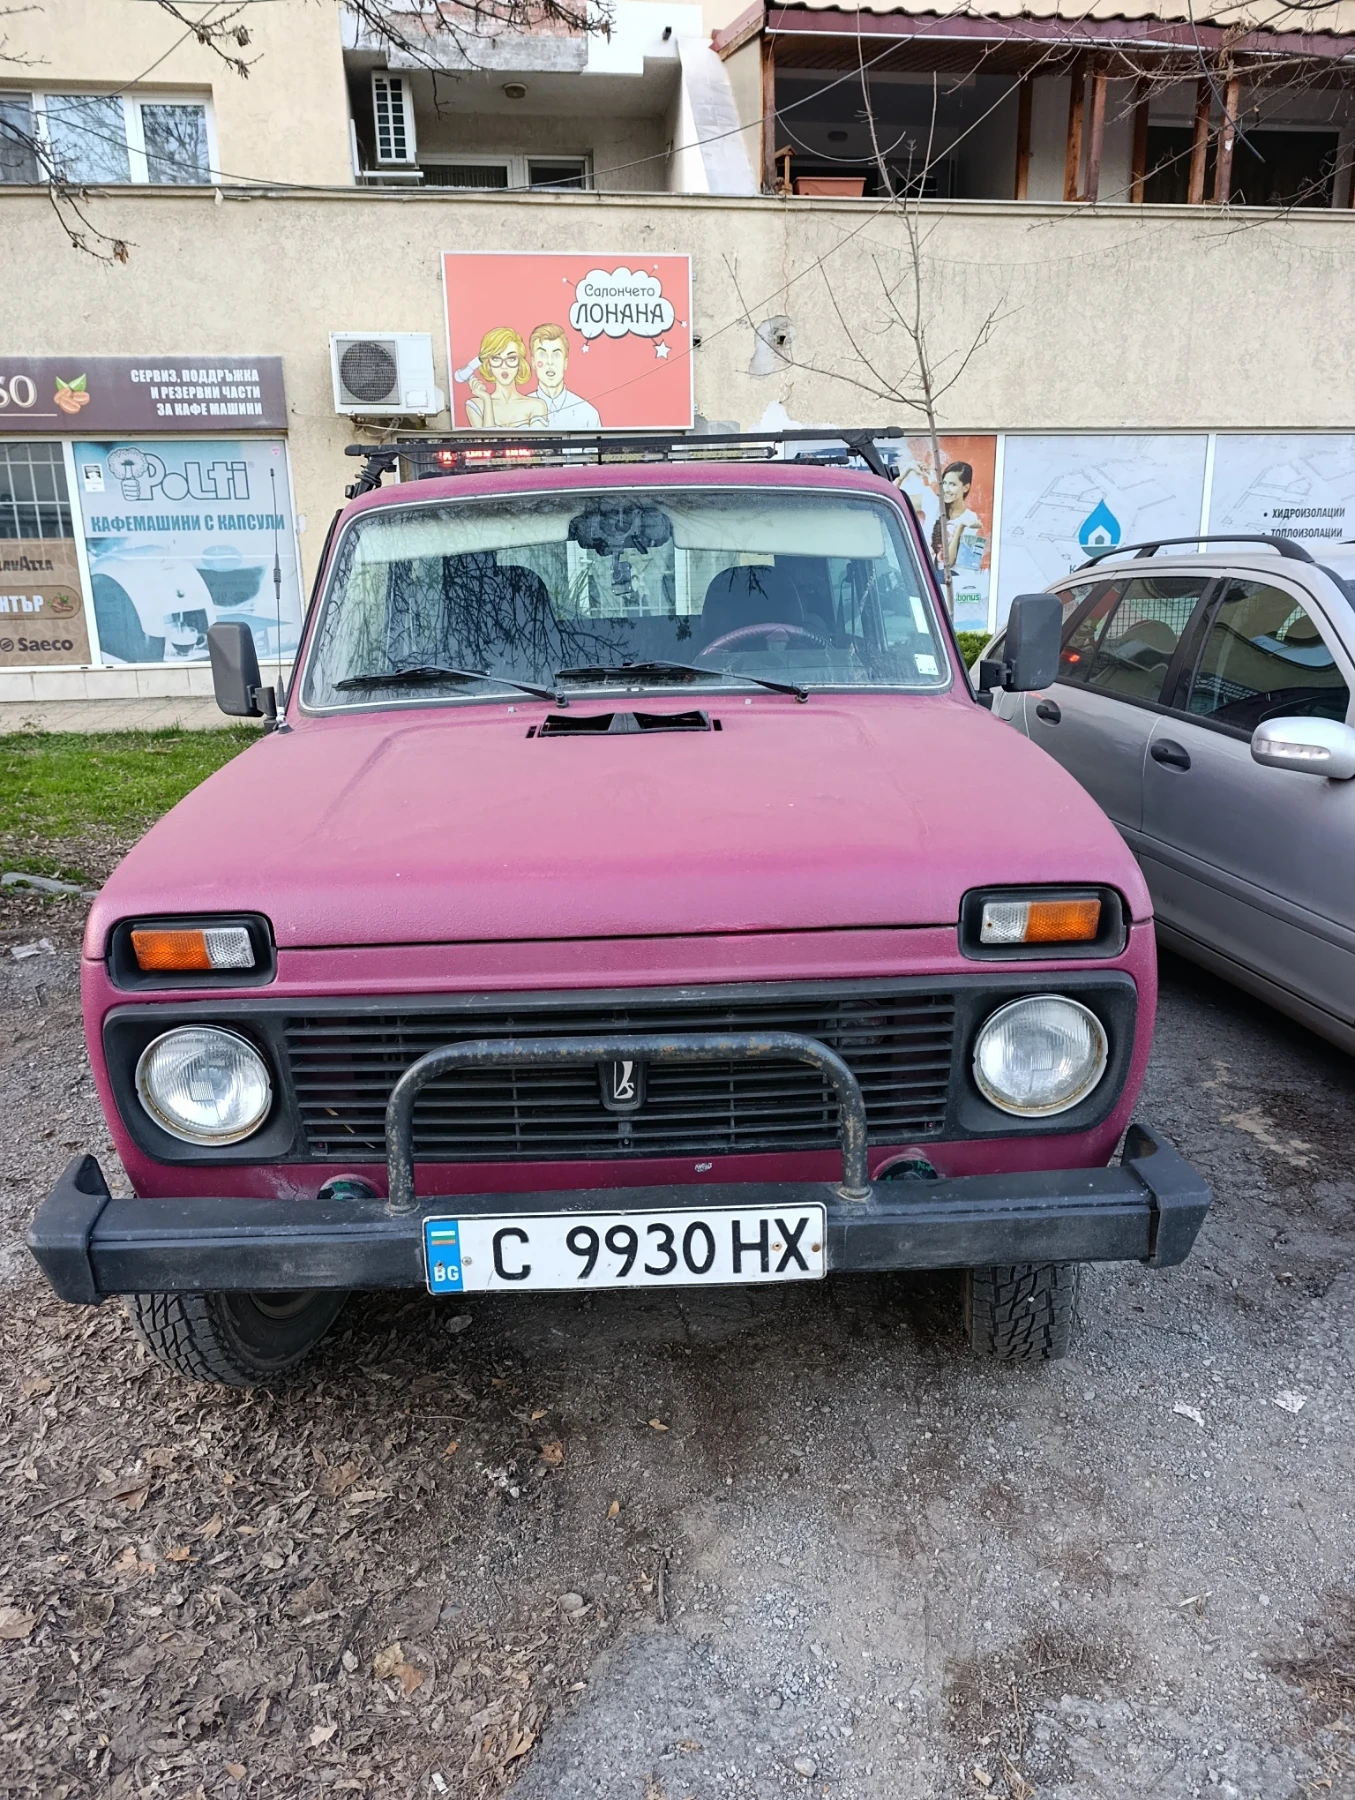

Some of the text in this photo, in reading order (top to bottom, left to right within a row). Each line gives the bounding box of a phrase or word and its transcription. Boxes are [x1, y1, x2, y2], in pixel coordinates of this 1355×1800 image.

[584, 283, 656, 298] Салончето
[575, 303, 665, 325] ЛОНАНА
[130, 369, 260, 384] СЕРВИЗ, ПОДДРЪЖКА
[150, 385, 261, 399] И РЕЗЕРВНИ ЧАСТИ
[156, 402, 263, 416] ЗА КАФЕ МАШИНИ
[1272, 507, 1346, 520] ХИДРОИЗОЛАЦИИ
[90, 514, 285, 532] КАФЕМАШИНИ С КАПСУЛИ
[1270, 527, 1343, 539] ТОПЛОИЗОЛАЦИИ
[0, 555, 54, 571] AVAZZA
[957, 593, 980, 602] bonus
[18, 637, 74, 652] Saeco
[491, 1217, 811, 1281] C 9930 HX
[433, 1264, 459, 1283] BG
